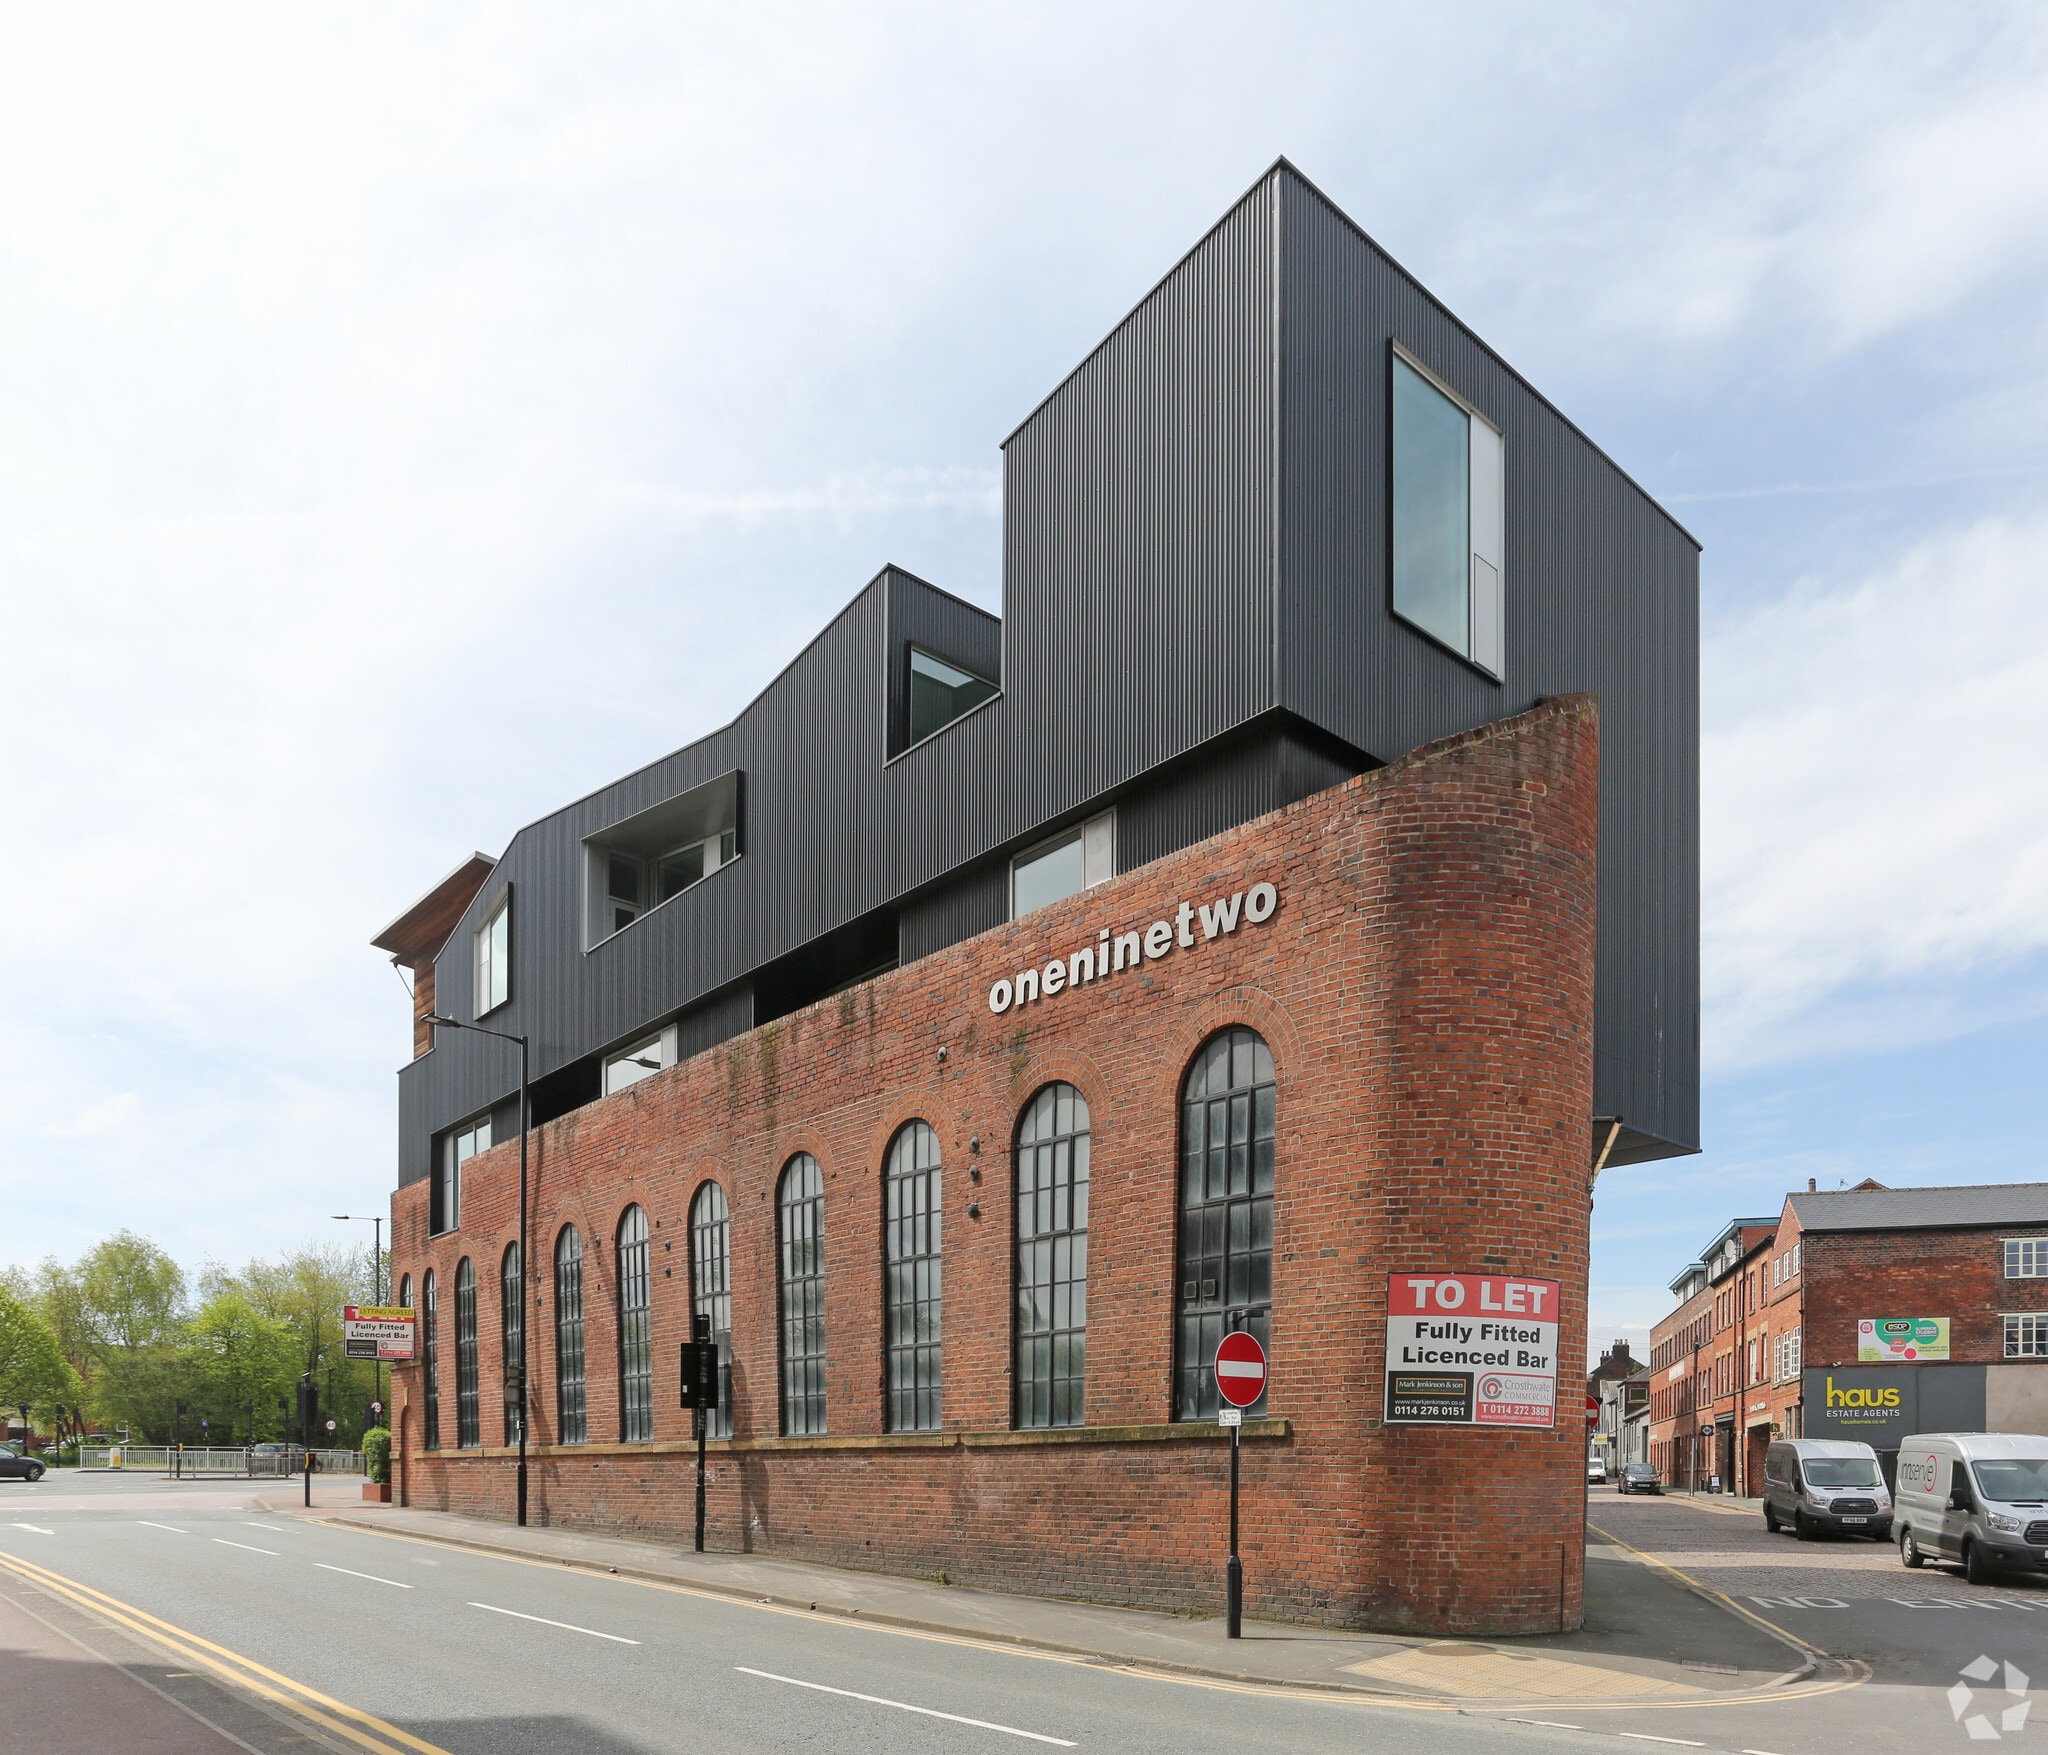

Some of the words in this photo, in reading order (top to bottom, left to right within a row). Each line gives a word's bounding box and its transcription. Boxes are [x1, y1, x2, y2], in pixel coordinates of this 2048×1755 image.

[988, 881, 1279, 1014] oneninetwo
[1407, 1279, 1466, 1309] TO
[1480, 1281, 1548, 1314] LET
[355, 1322, 377, 1331] Fully
[379, 1323, 405, 1331] Fitted
[1415, 1321, 1473, 1344] Fully
[1480, 1323, 1541, 1344] Fitted
[351, 1331, 391, 1339] Licenced
[1402, 1346, 1510, 1366] Licenced
[1516, 1350, 1549, 1369] Bar
[1398, 1380, 1416, 1388] Mark
[1416, 1380, 1445, 1389] Jenkinson
[1504, 1379, 1551, 1393] Crosthwaite
[1504, 1392, 1550, 1402] COMMERCIAL
[1826, 1376, 1901, 1408] haus
[1394, 1398, 1466, 1406] www.markjenkinson.co.uk
[1394, 1405, 1419, 1415] 0114
[1420, 1406, 1439, 1416] 276
[1442, 1406, 1465, 1416] 0151
[1481, 1404, 1489, 1413] T
[1490, 1405, 1512, 1414] 0114
[1514, 1406, 1530, 1415] 272
[1531, 1407, 1550, 1416] 3888
[1826, 1409, 1860, 1418] ESTATE
[1863, 1409, 1901, 1417] AGENTS
[1900, 1461, 1934, 1482] innserve
[1748, 1596, 1850, 1609] NO
